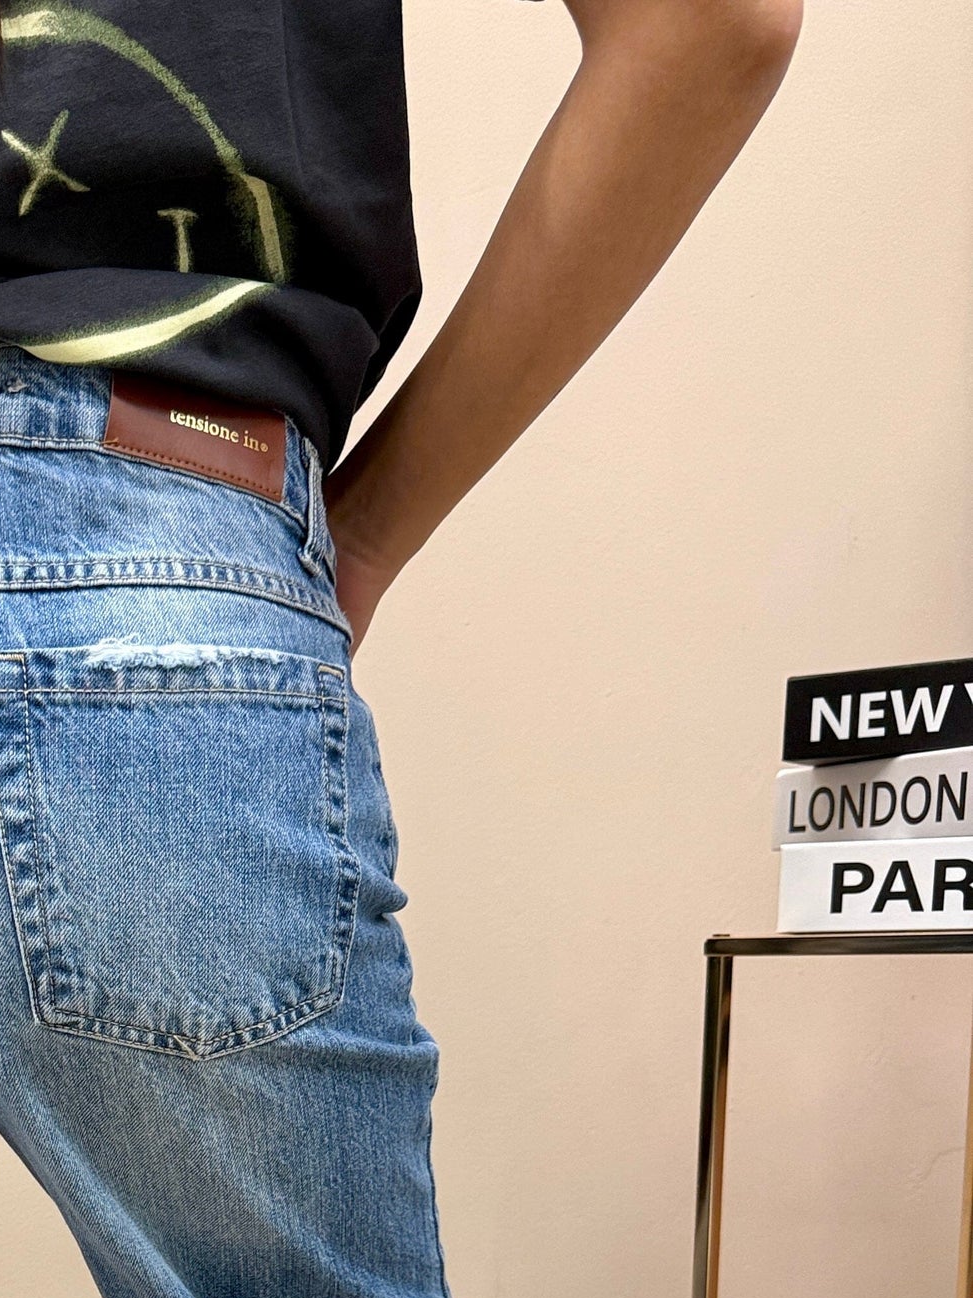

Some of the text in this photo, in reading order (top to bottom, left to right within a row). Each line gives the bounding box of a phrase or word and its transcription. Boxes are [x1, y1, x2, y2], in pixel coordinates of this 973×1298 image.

[169, 408, 239, 443] tensione
[809, 684, 954, 743] NEW
[788, 771, 968, 833] LONDON
